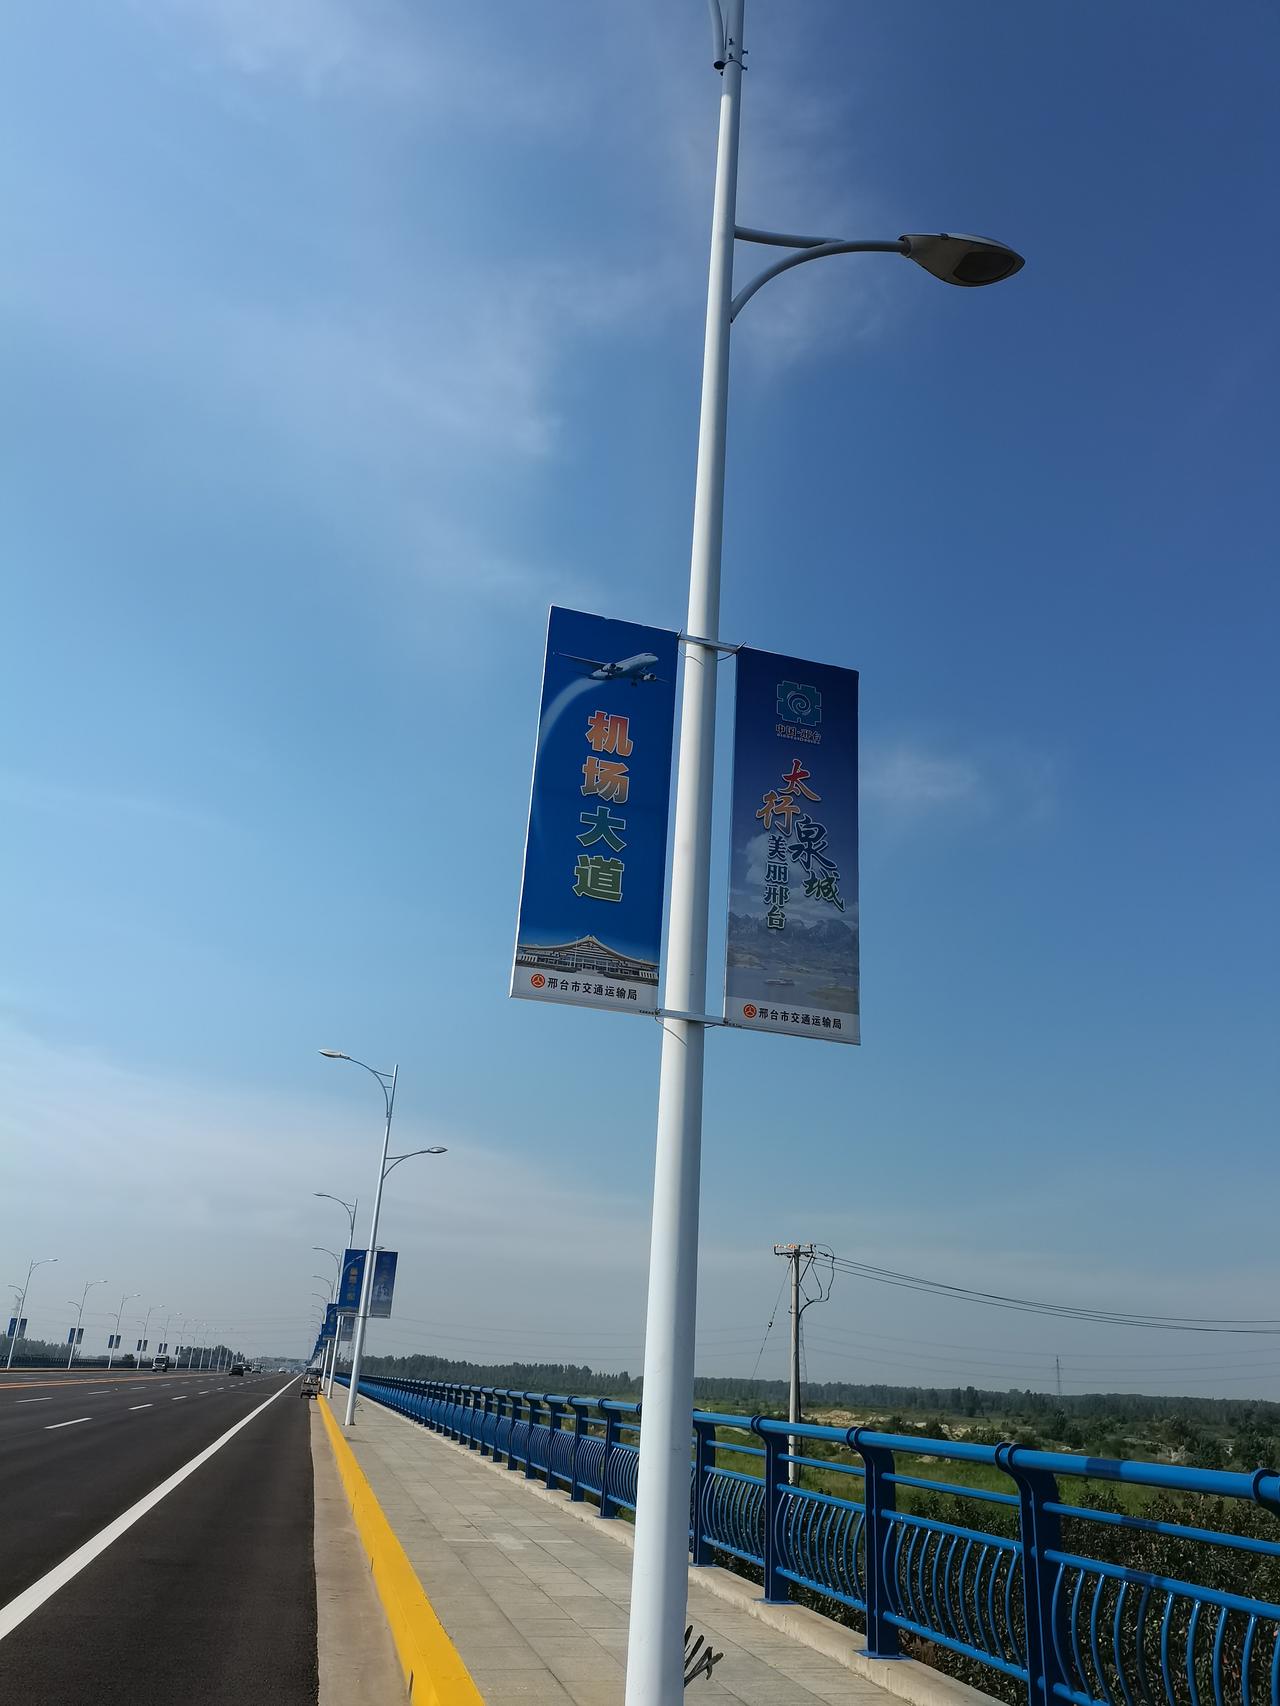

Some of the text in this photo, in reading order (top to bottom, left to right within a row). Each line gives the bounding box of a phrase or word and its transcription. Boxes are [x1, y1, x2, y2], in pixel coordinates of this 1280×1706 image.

[572, 711, 633, 902] 机场大道
[764, 834, 790, 930] 美丽邢台
[547, 977, 638, 1001] 邢台市交通运输局
[758, 1007, 842, 1030] 邢台市交通运输局
